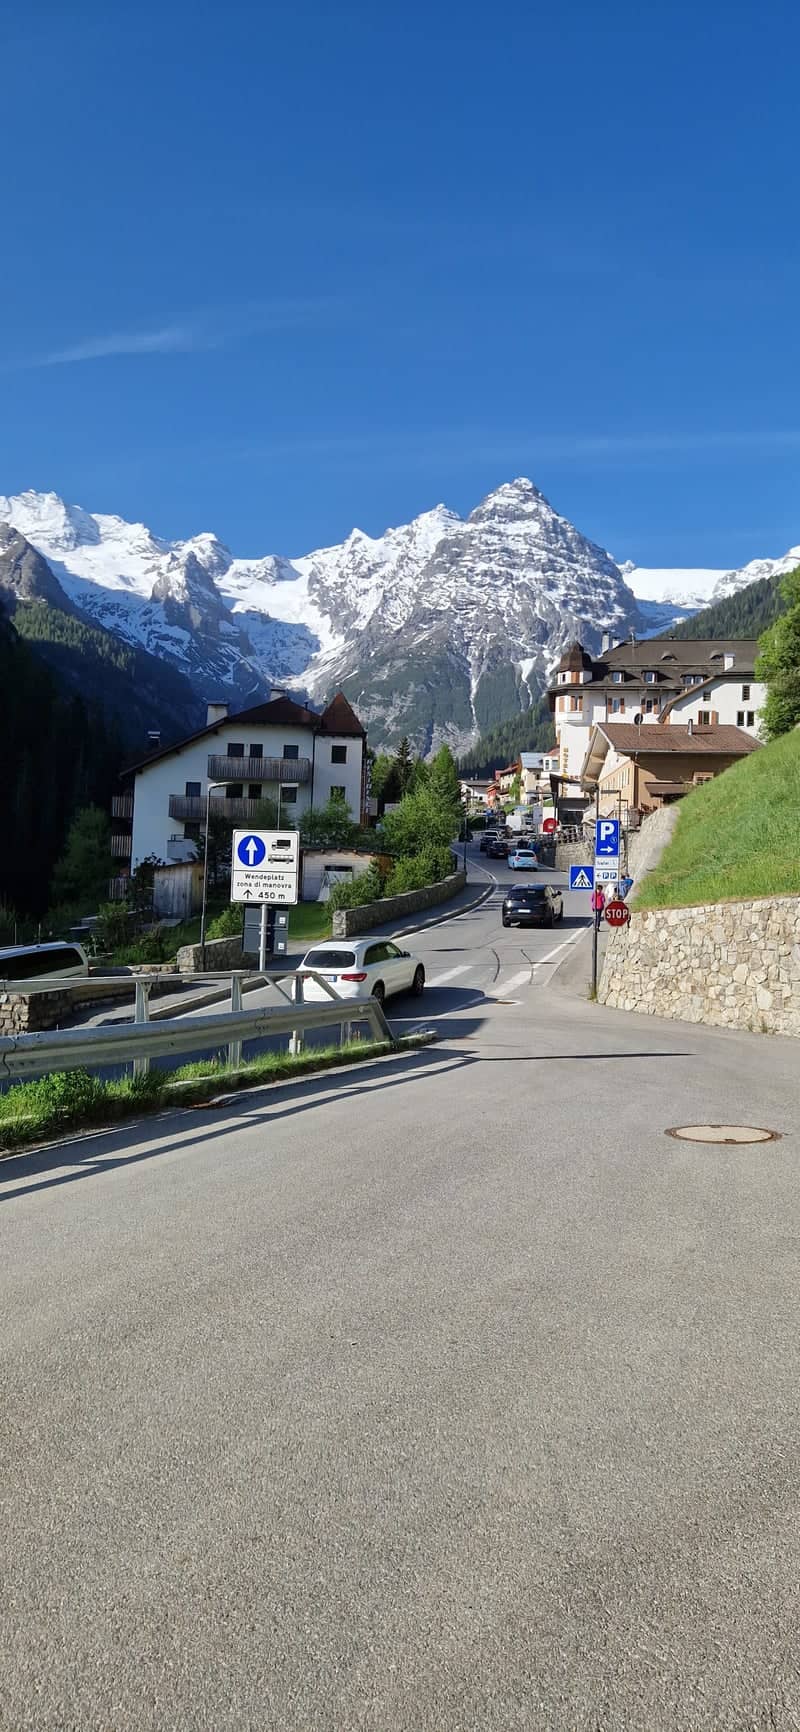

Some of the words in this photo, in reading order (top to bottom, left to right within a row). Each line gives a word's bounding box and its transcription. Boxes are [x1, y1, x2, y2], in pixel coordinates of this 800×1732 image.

[600, 822, 615, 841] P
[244, 873, 285, 881] Wendeplatz
[258, 891, 276, 899] 450
[606, 908, 628, 919] STOP
